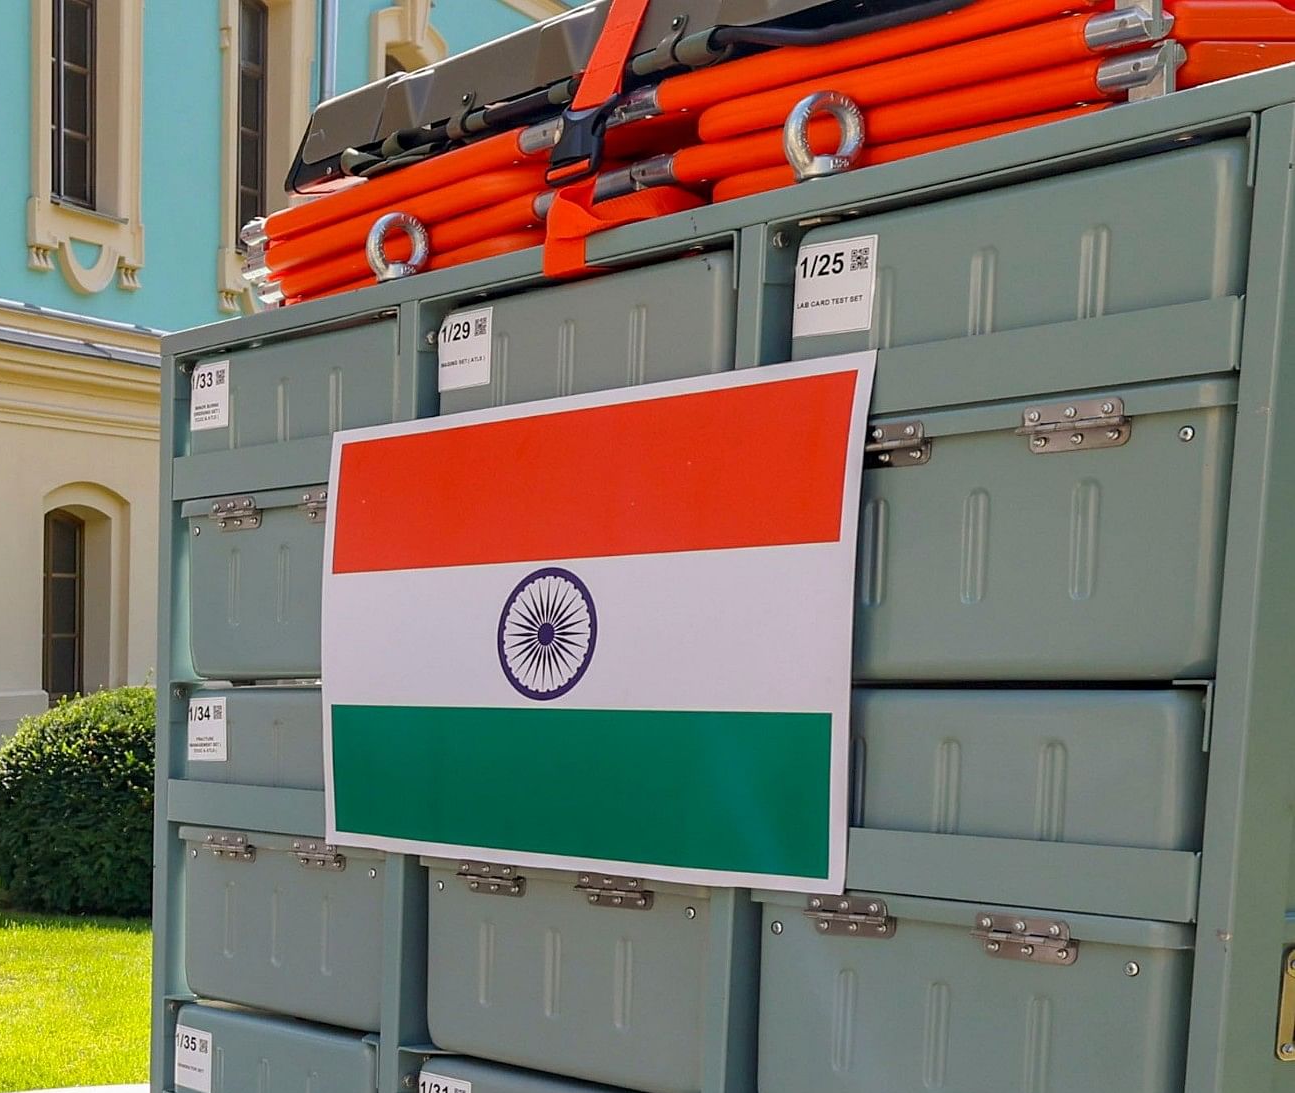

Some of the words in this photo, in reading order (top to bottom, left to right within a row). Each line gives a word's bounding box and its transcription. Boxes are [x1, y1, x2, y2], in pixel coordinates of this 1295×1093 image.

[801, 252, 844, 278] 1/25
[441, 321, 470, 343] 1/29
[193, 372, 213, 390] 1/33
[189, 705, 210, 721] 1/34
[177, 1033, 197, 1051] 1/35
